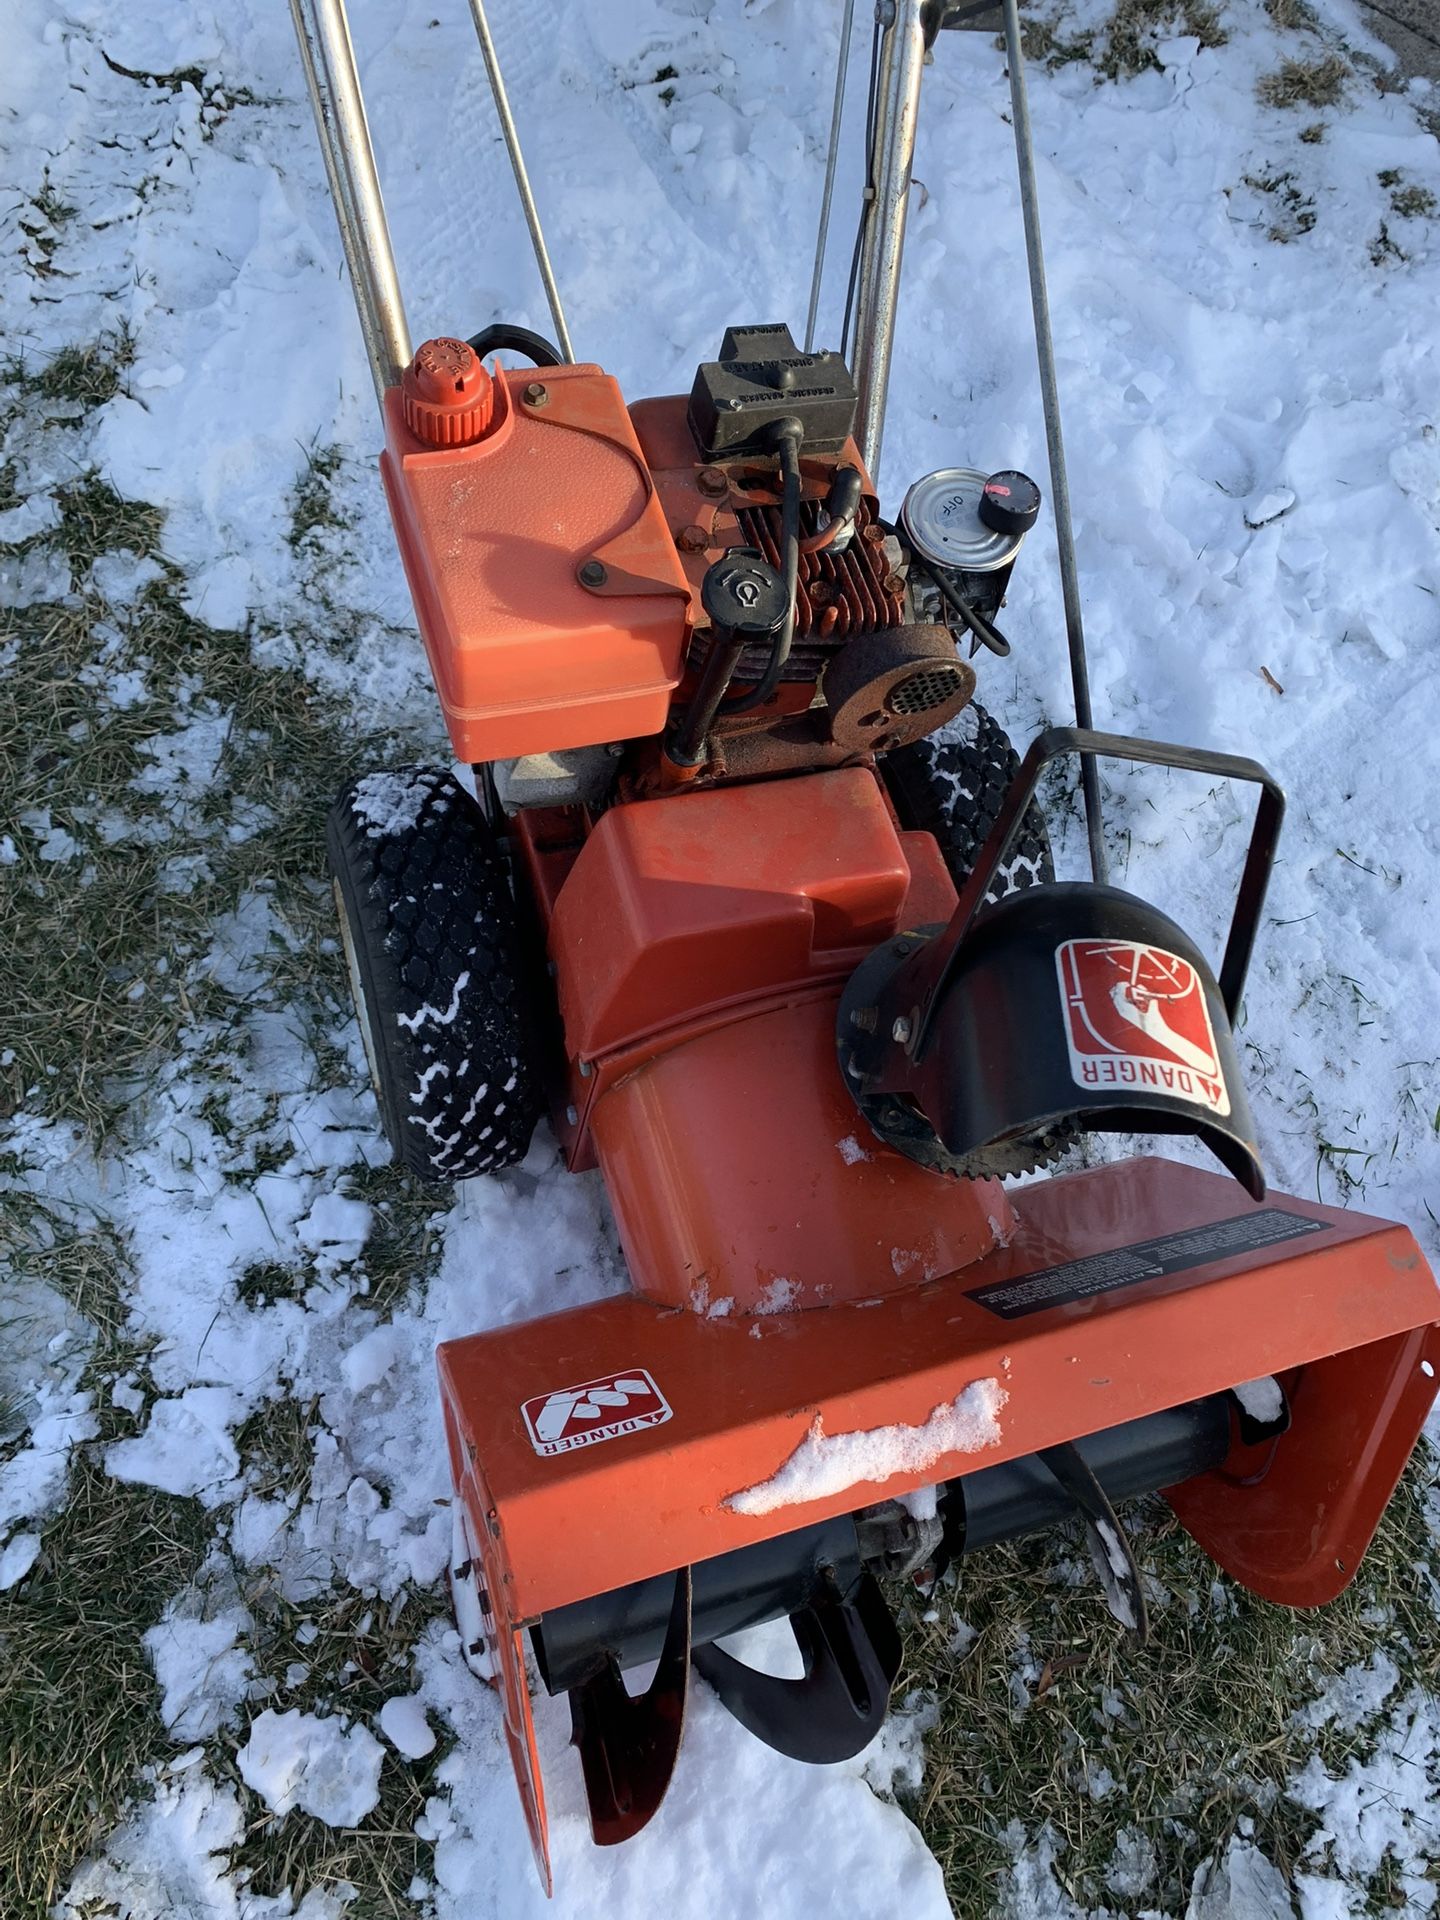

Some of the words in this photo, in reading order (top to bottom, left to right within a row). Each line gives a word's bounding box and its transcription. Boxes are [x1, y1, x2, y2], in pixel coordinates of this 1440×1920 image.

[942, 495, 964, 516] OFF
[1082, 1060, 1194, 1094] DANGER
[1078, 1272, 1145, 1294] ATTENTION
[543, 1420, 637, 1454] DANGER
